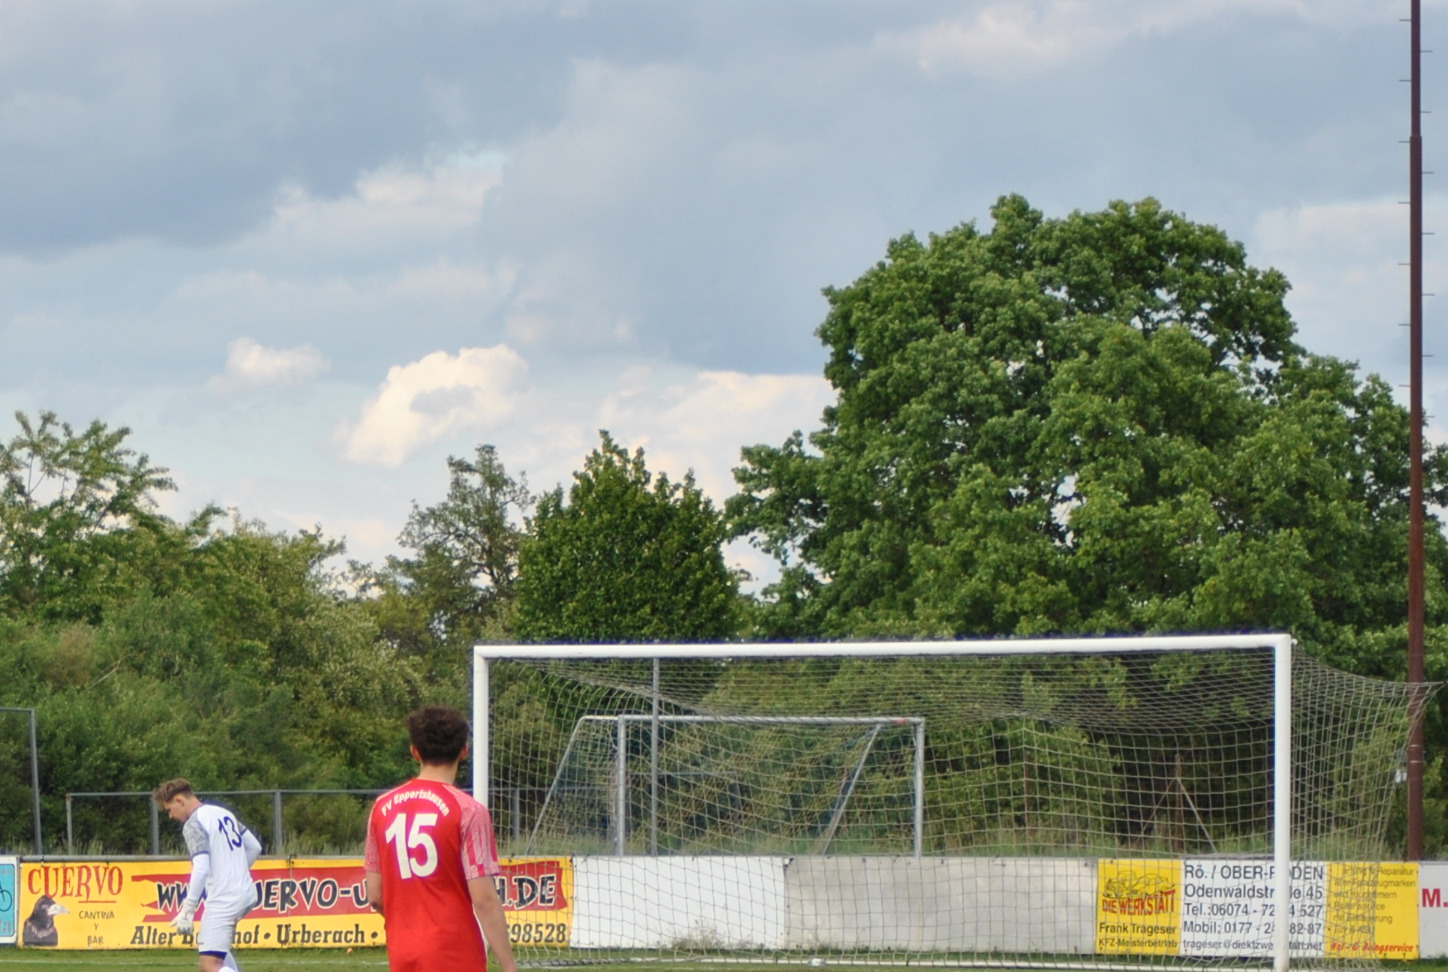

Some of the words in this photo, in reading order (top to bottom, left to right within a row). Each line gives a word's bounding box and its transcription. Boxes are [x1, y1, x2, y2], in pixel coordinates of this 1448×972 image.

[393, 789, 449, 817] Eppertshausen
[218, 815, 242, 851] 13
[385, 813, 438, 879] 15
[27, 865, 123, 901] CUERVO
[1305, 886, 1323, 899] 45
[1102, 899, 1118, 914] DIE
[1119, 888, 1177, 916] WERKSTATT
[78, 910, 115, 920] CANTINA
[1300, 905, 1323, 918] 527
[93, 922, 99, 930] Y
[1099, 922, 1129, 934] Frank
[1131, 923, 1177, 937] Trageser
[1224, 922, 1252, 934] 0177
[87, 934, 104, 945] BAR
[130, 925, 177, 945] Alter
[277, 923, 366, 945] Urberach
[508, 922, 567, 943] 98528
[1098, 939, 1177, 948] KFZ-Meisterbetrieb
